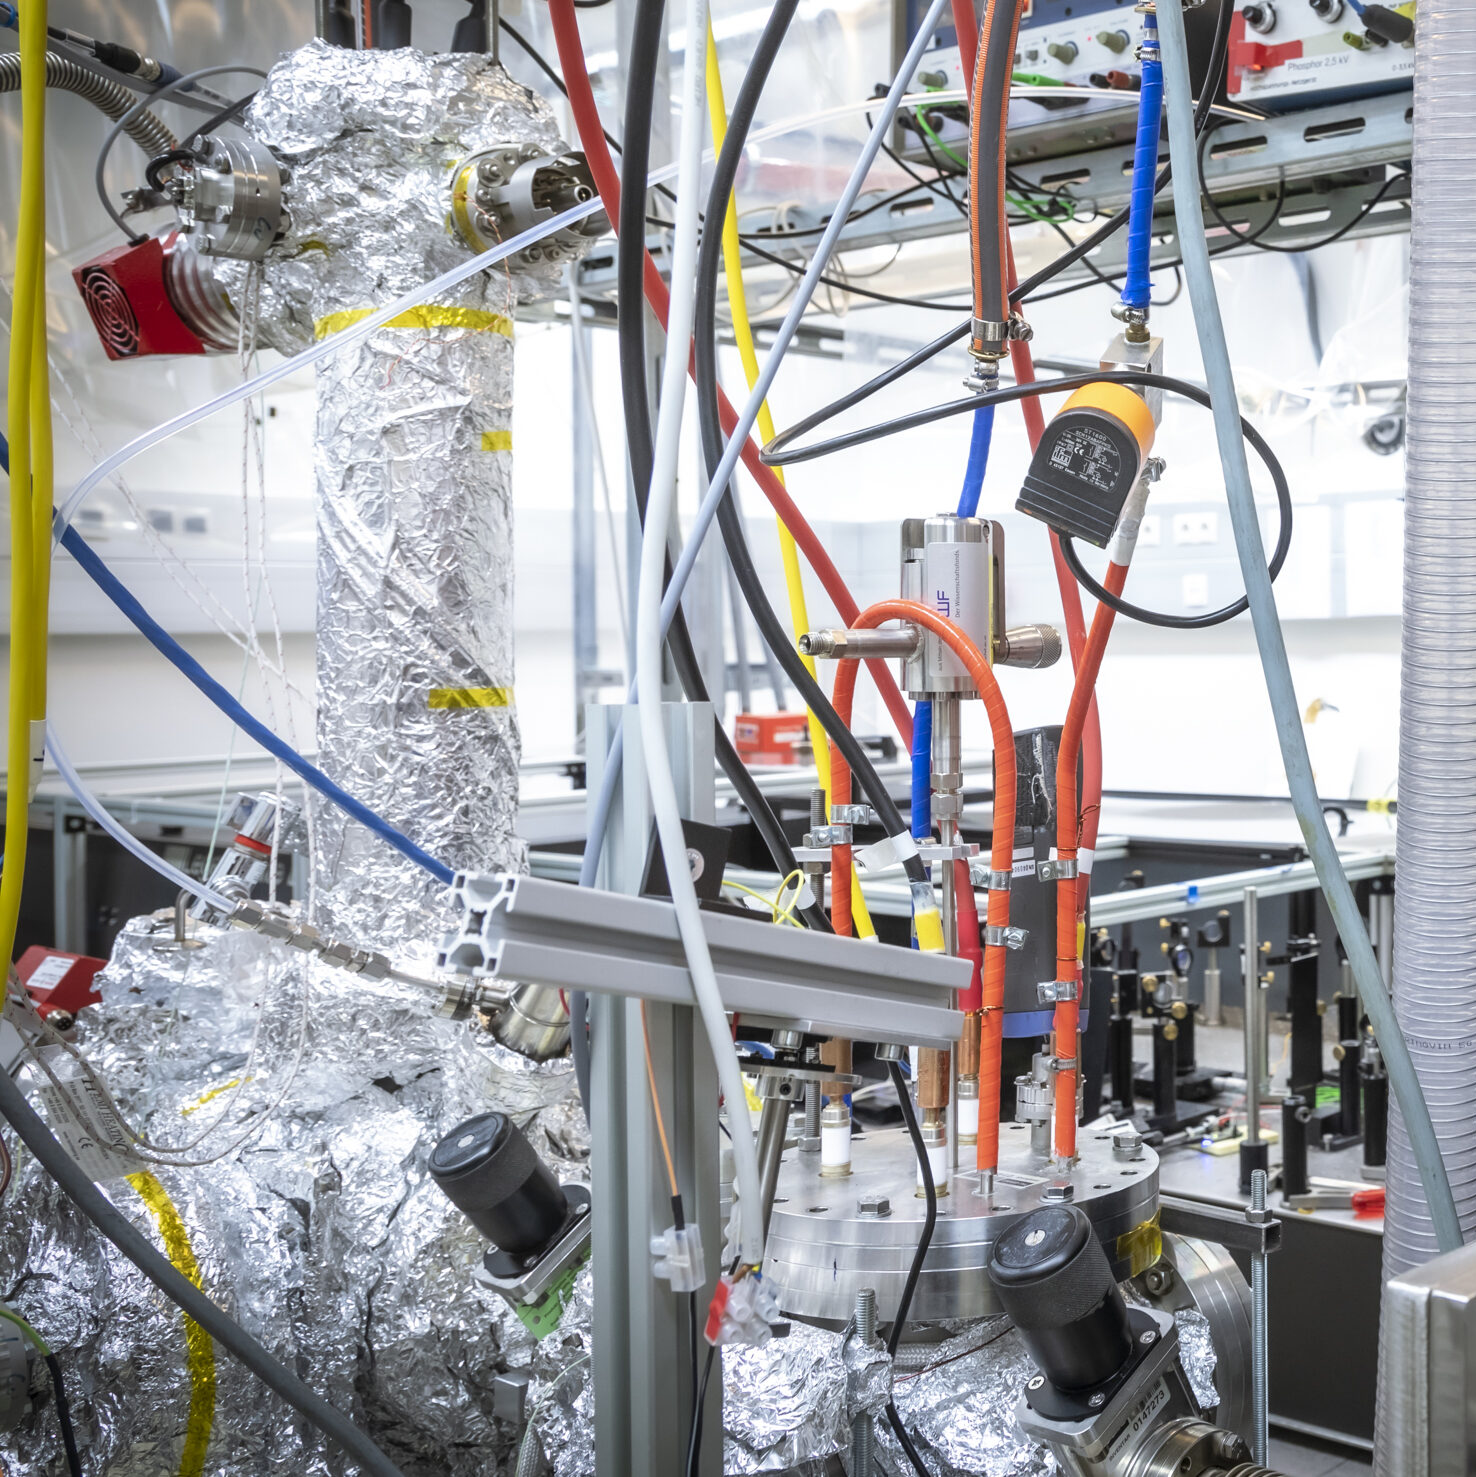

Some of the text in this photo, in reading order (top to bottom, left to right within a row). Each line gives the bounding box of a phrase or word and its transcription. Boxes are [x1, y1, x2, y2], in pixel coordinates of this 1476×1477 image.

[1287, 53, 1349, 72] Phosphor 2,5 kV
[1108, 1389, 1165, 1461] INVENTAR 0147273
